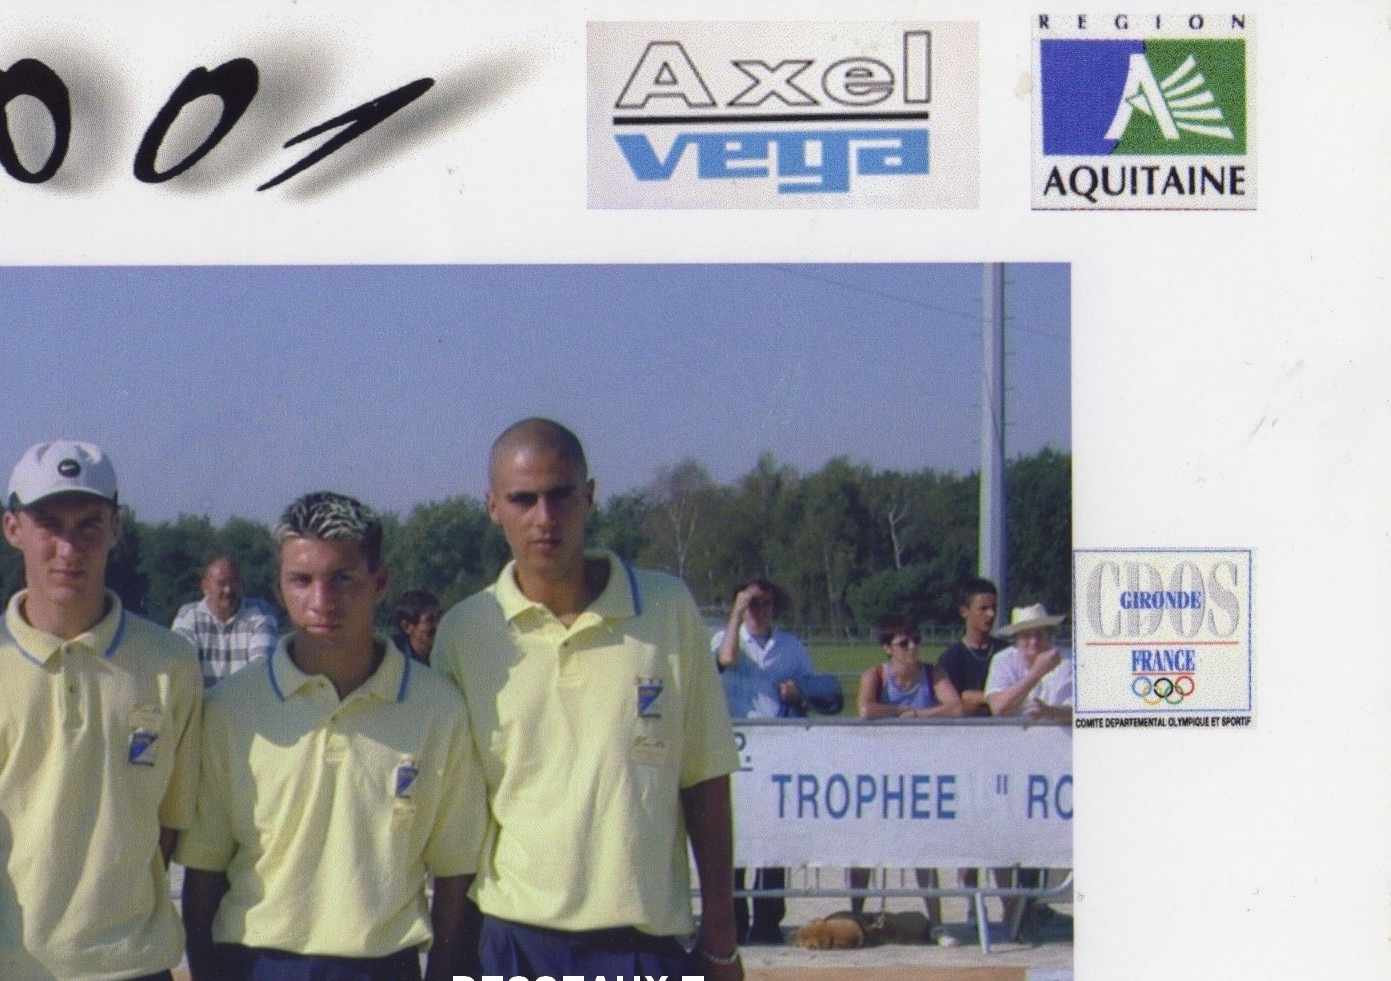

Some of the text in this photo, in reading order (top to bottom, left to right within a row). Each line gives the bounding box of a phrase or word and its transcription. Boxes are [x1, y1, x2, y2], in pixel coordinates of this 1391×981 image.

[1039, 14, 1246, 29] REGION
[614, 31, 931, 109] Axel
[613, 128, 930, 194] vega
[1043, 165, 1246, 203] AQUITAINE
[1086, 560, 1240, 638] CDOS
[1120, 591, 1202, 610] GIRONDE
[1131, 650, 1196, 672] FRANCE
[1075, 716, 1252, 728] COMITE DEPARTEMENTAL OLYMPIQUE ET SPORTIF
[772, 774, 957, 819] TROPHEE
